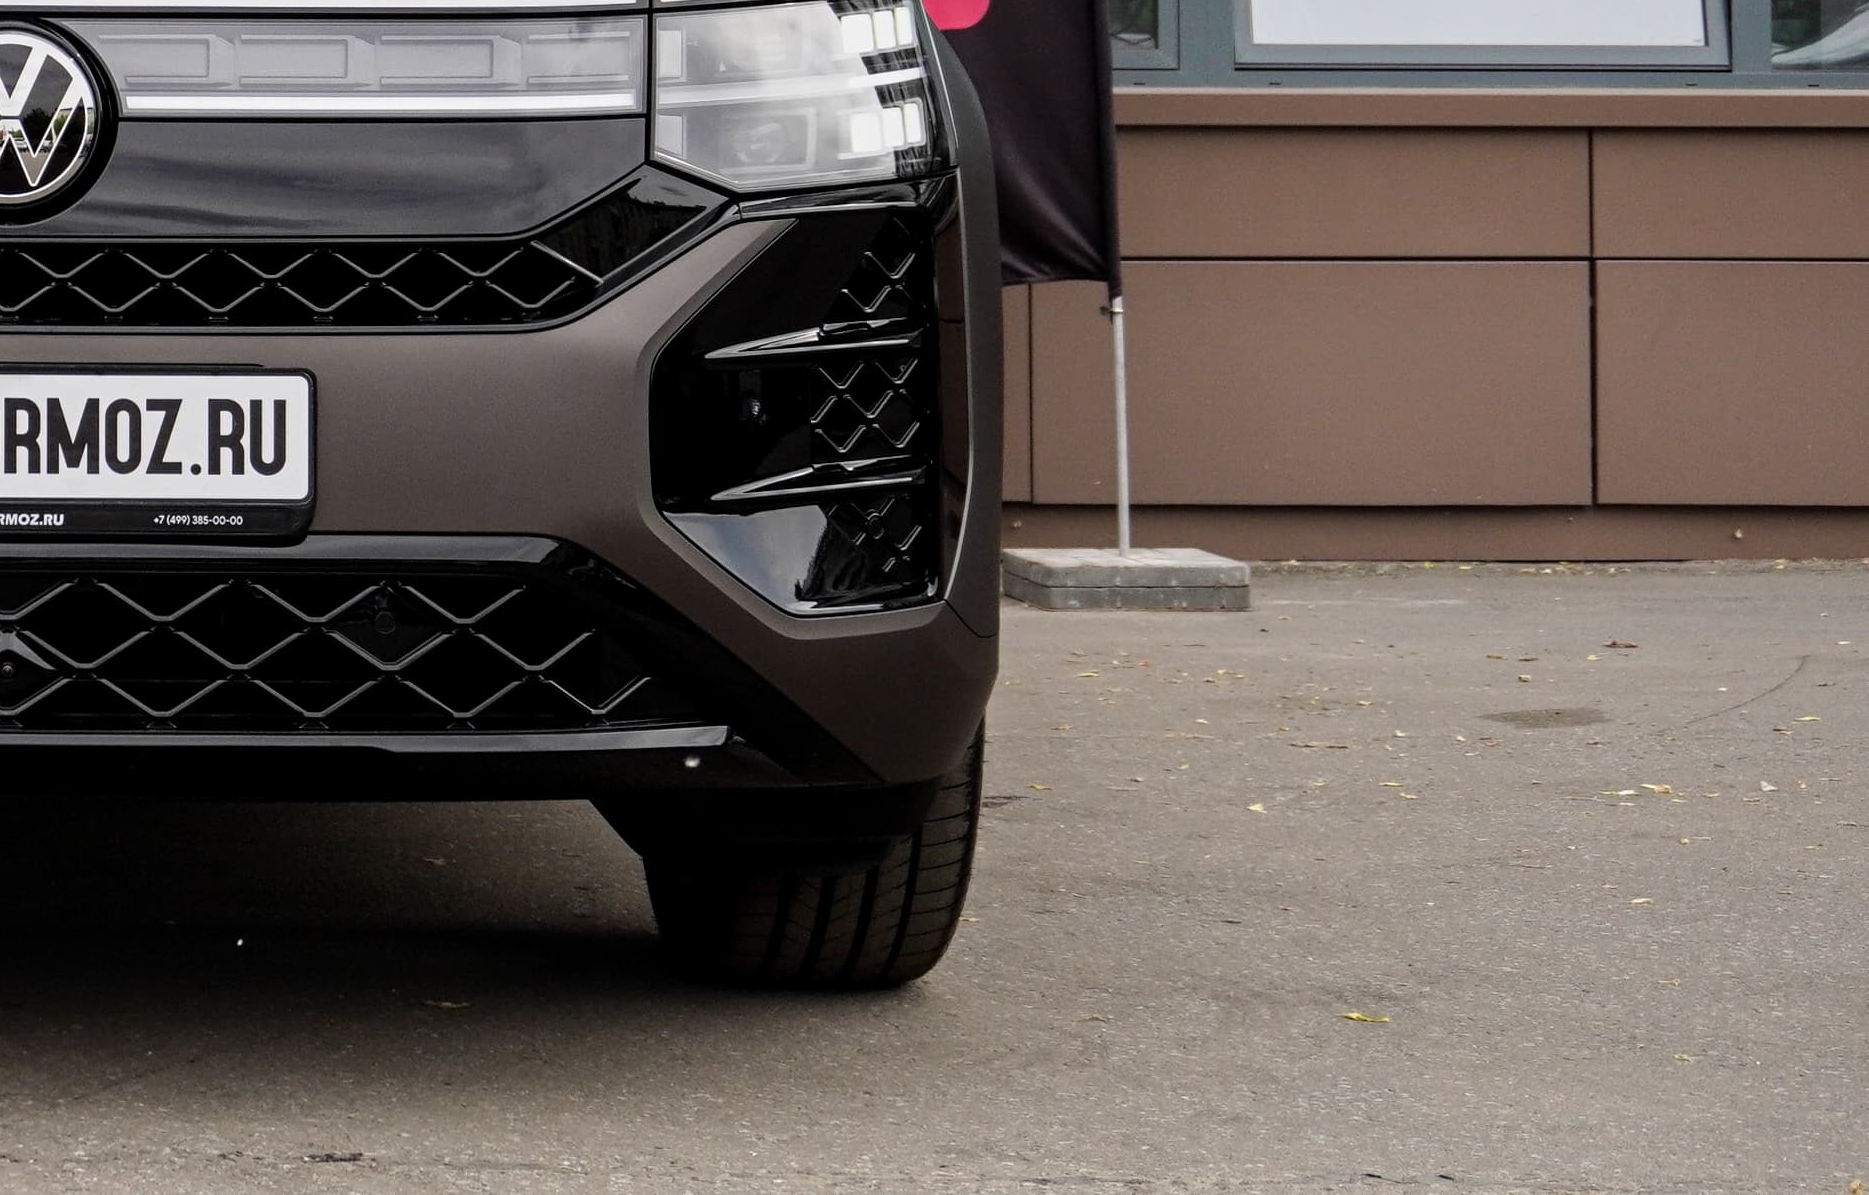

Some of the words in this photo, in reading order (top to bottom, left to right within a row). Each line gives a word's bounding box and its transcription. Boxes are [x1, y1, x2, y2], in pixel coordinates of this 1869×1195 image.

[153, 515, 165, 525] +7
[166, 514, 191, 526] (499)
[191, 515, 244, 525] 385-00-00
